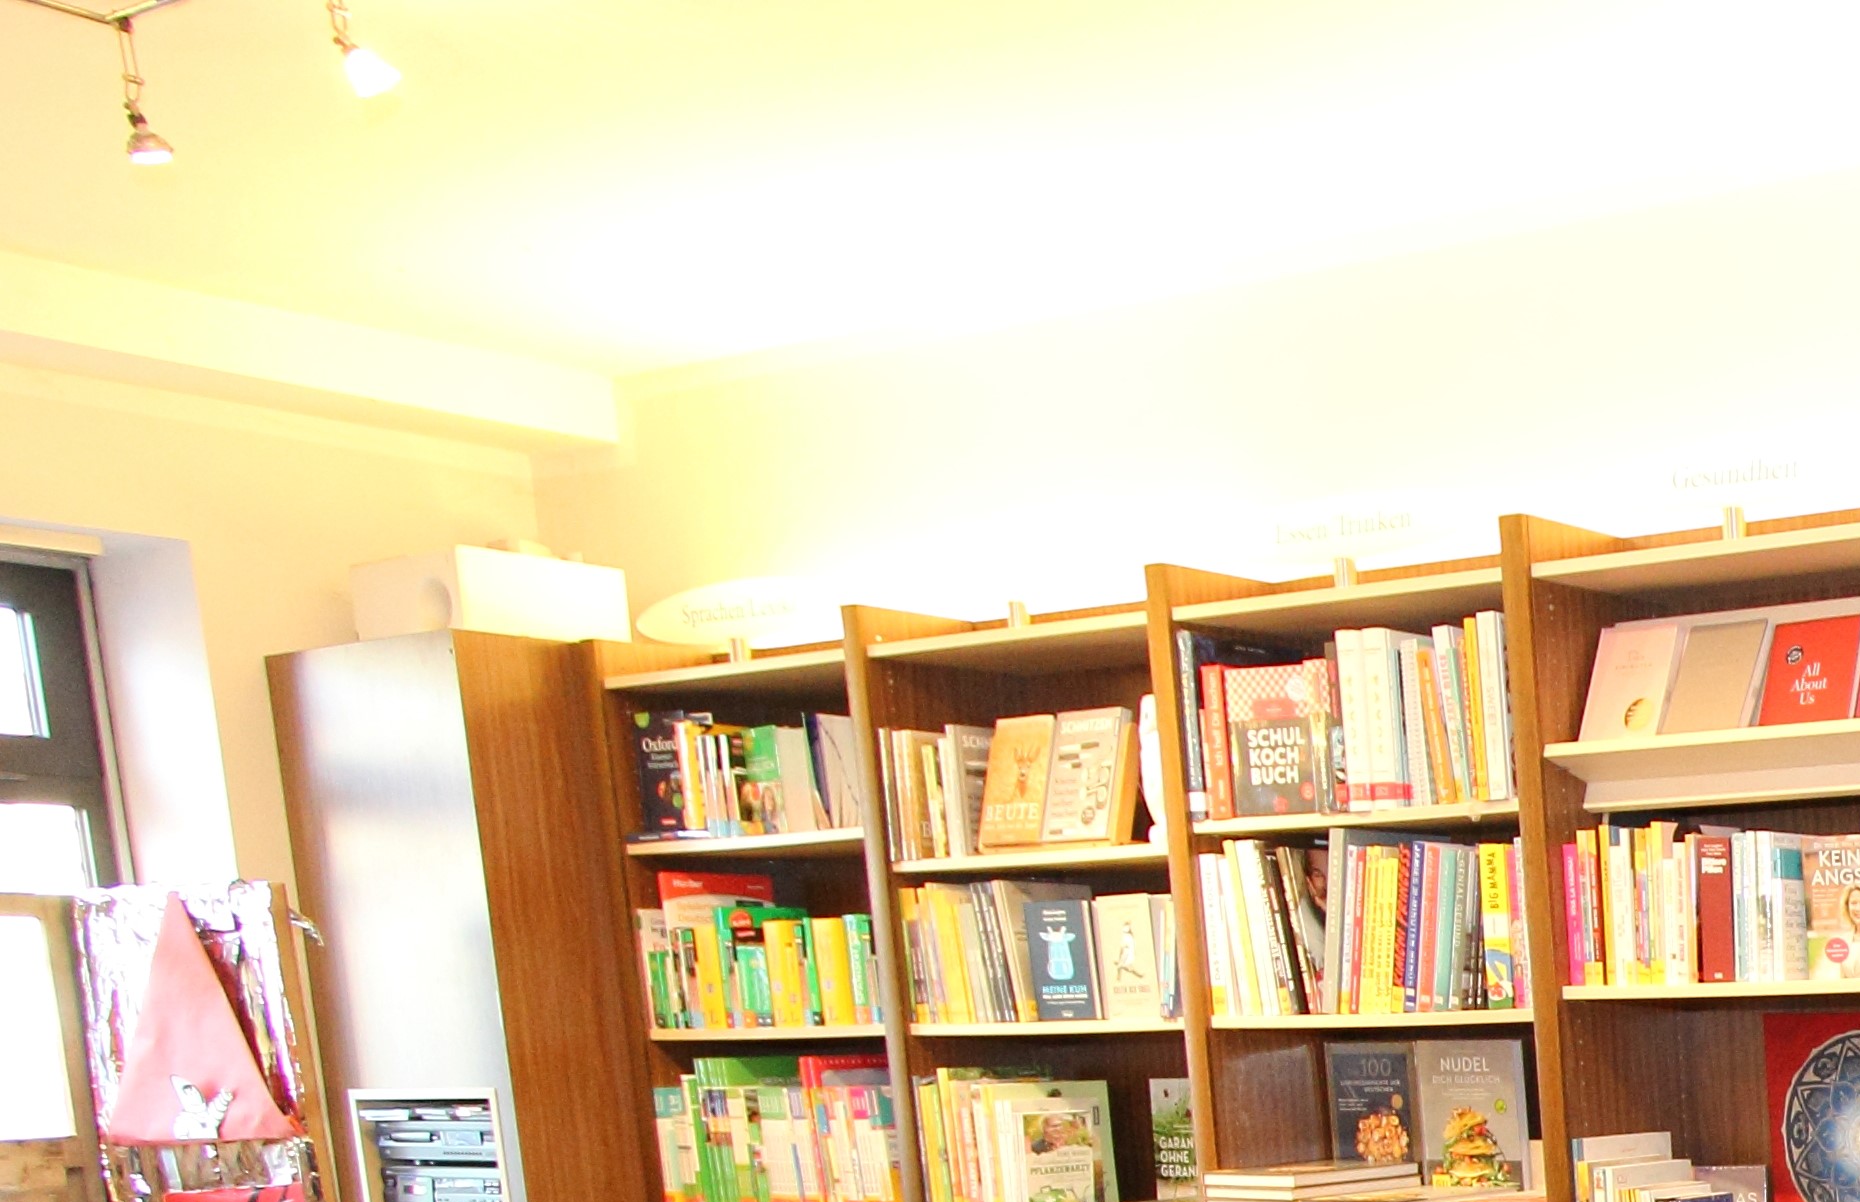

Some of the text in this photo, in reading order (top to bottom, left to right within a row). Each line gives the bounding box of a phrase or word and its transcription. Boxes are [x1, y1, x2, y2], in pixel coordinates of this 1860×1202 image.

[1669, 457, 1799, 491] Gesundheit
[681, 603, 744, 627] Sprachen
[1803, 662, 1821, 677] All
[1790, 678, 1828, 692] About
[1799, 692, 1815, 706] Us
[1247, 726, 1305, 747] SCHUL
[641, 739, 677, 757] Oxfor
[1249, 746, 1300, 766] KOCH
[1251, 766, 1300, 786] BUCH
[985, 799, 1041, 824] BEUTE
[1396, 843, 1412, 926] PRINCESS
[1486, 851, 1500, 910] BIG MAMMA
[1360, 1058, 1392, 1077] 100
[1440, 1057, 1490, 1073] NUDEL
[1159, 1136, 1195, 1150] GARAN
[1160, 1150, 1190, 1163] OHNE
